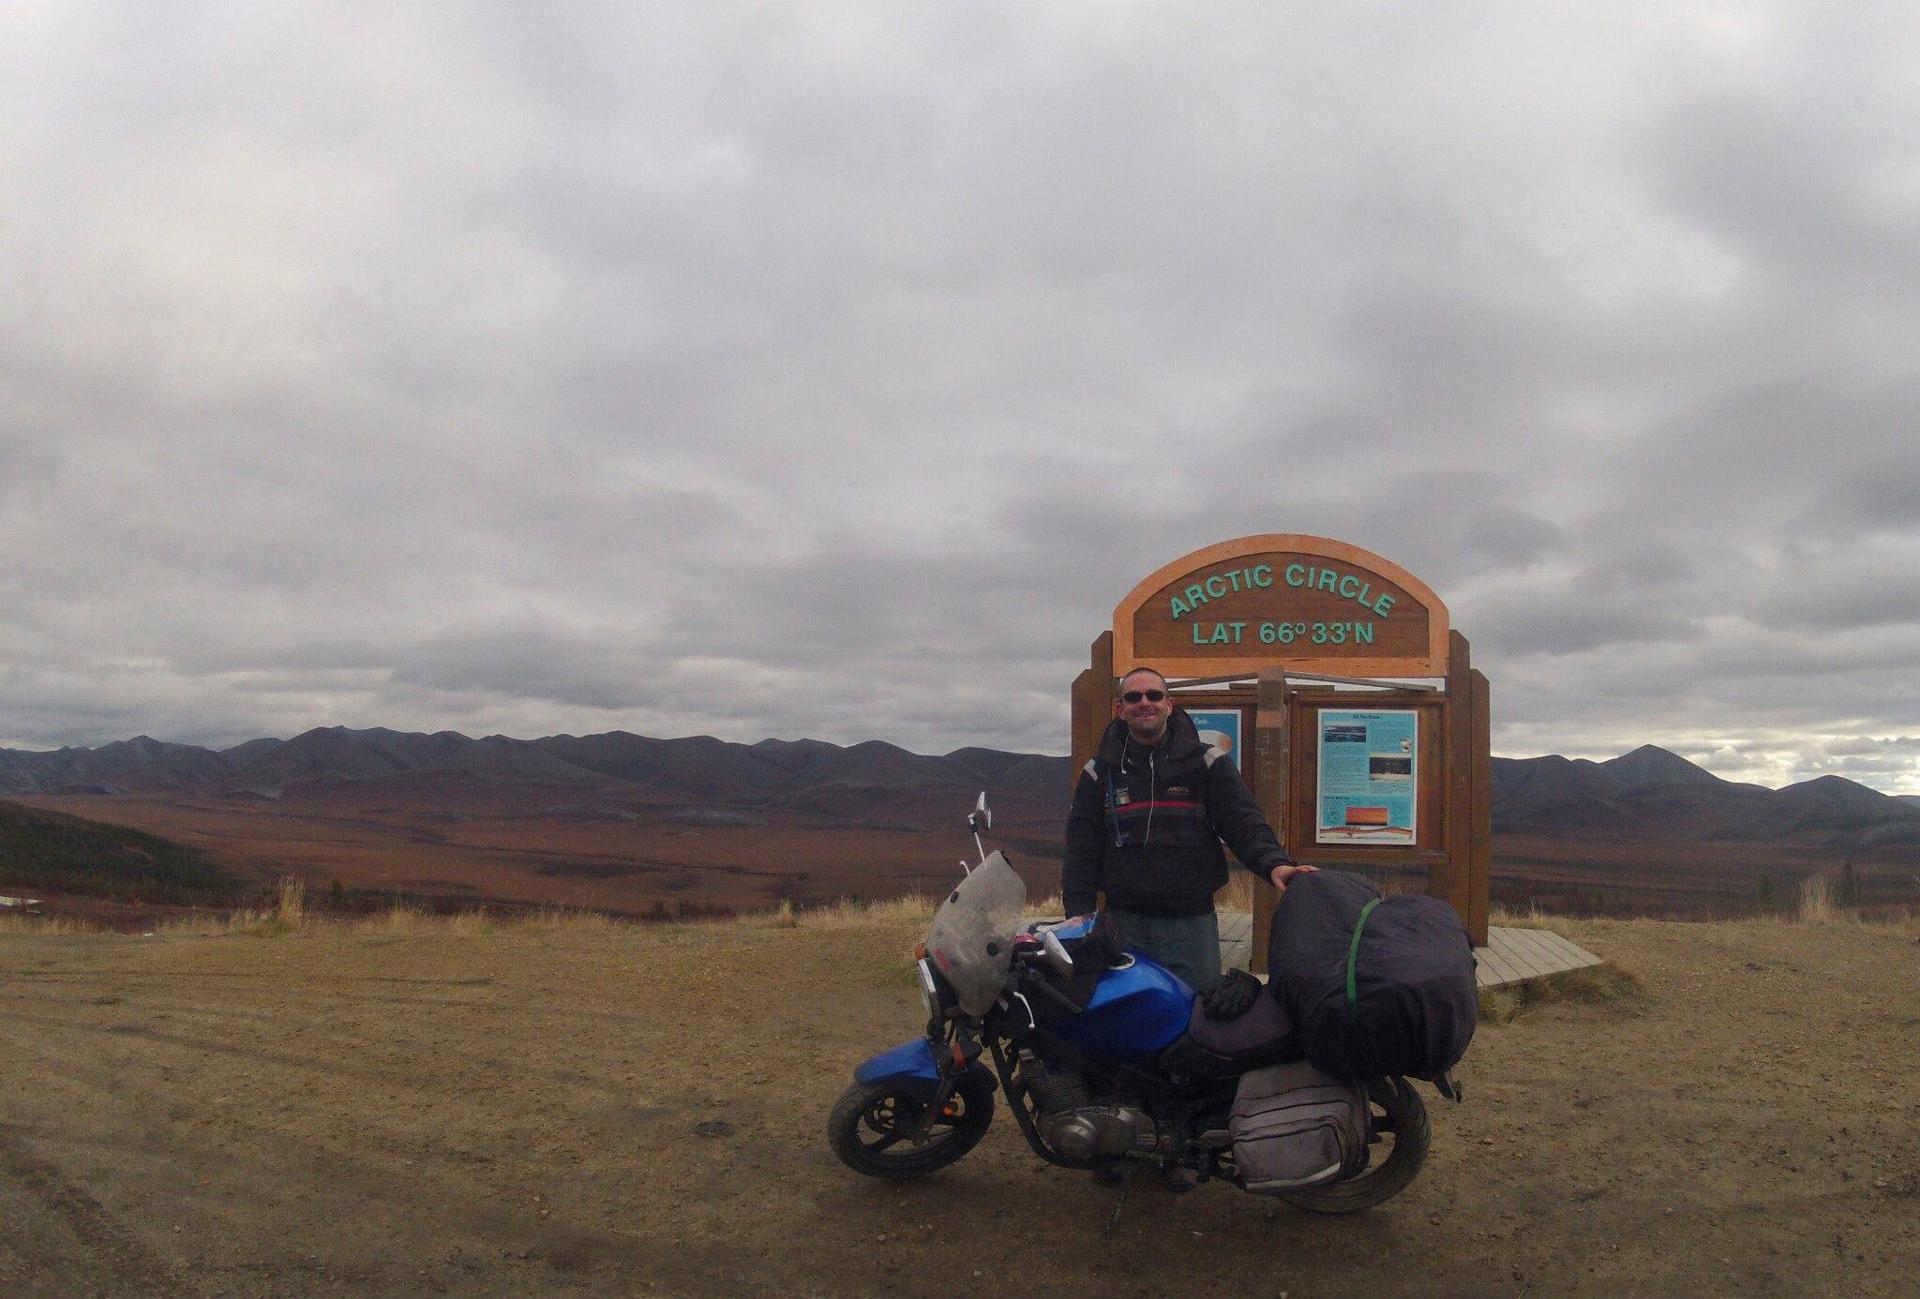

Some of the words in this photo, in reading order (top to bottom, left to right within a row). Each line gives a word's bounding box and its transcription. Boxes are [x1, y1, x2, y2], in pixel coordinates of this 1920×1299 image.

[1169, 564, 1273, 619] ARCTIC
[1285, 563, 1397, 618] CIRCLE
[1192, 622, 1246, 644] LAT
